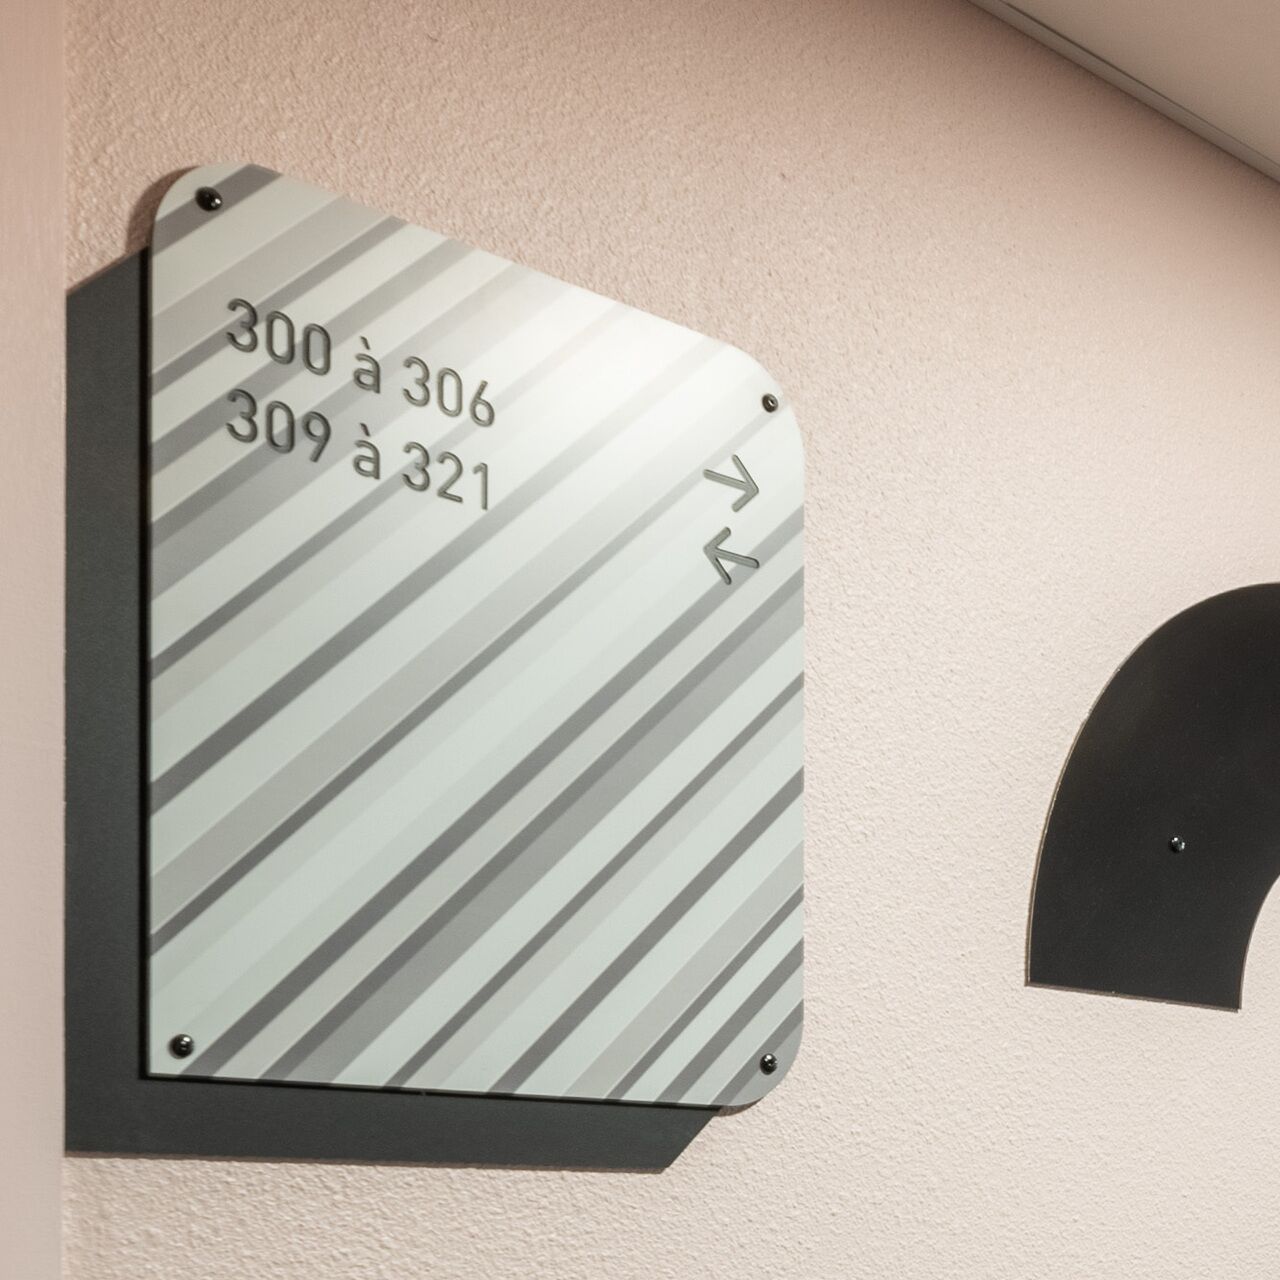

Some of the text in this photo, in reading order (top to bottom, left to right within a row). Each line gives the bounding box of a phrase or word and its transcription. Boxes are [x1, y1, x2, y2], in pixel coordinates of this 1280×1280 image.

[226, 297, 496, 428] 300 à 306
[225, 388, 489, 511] 309 à 321
